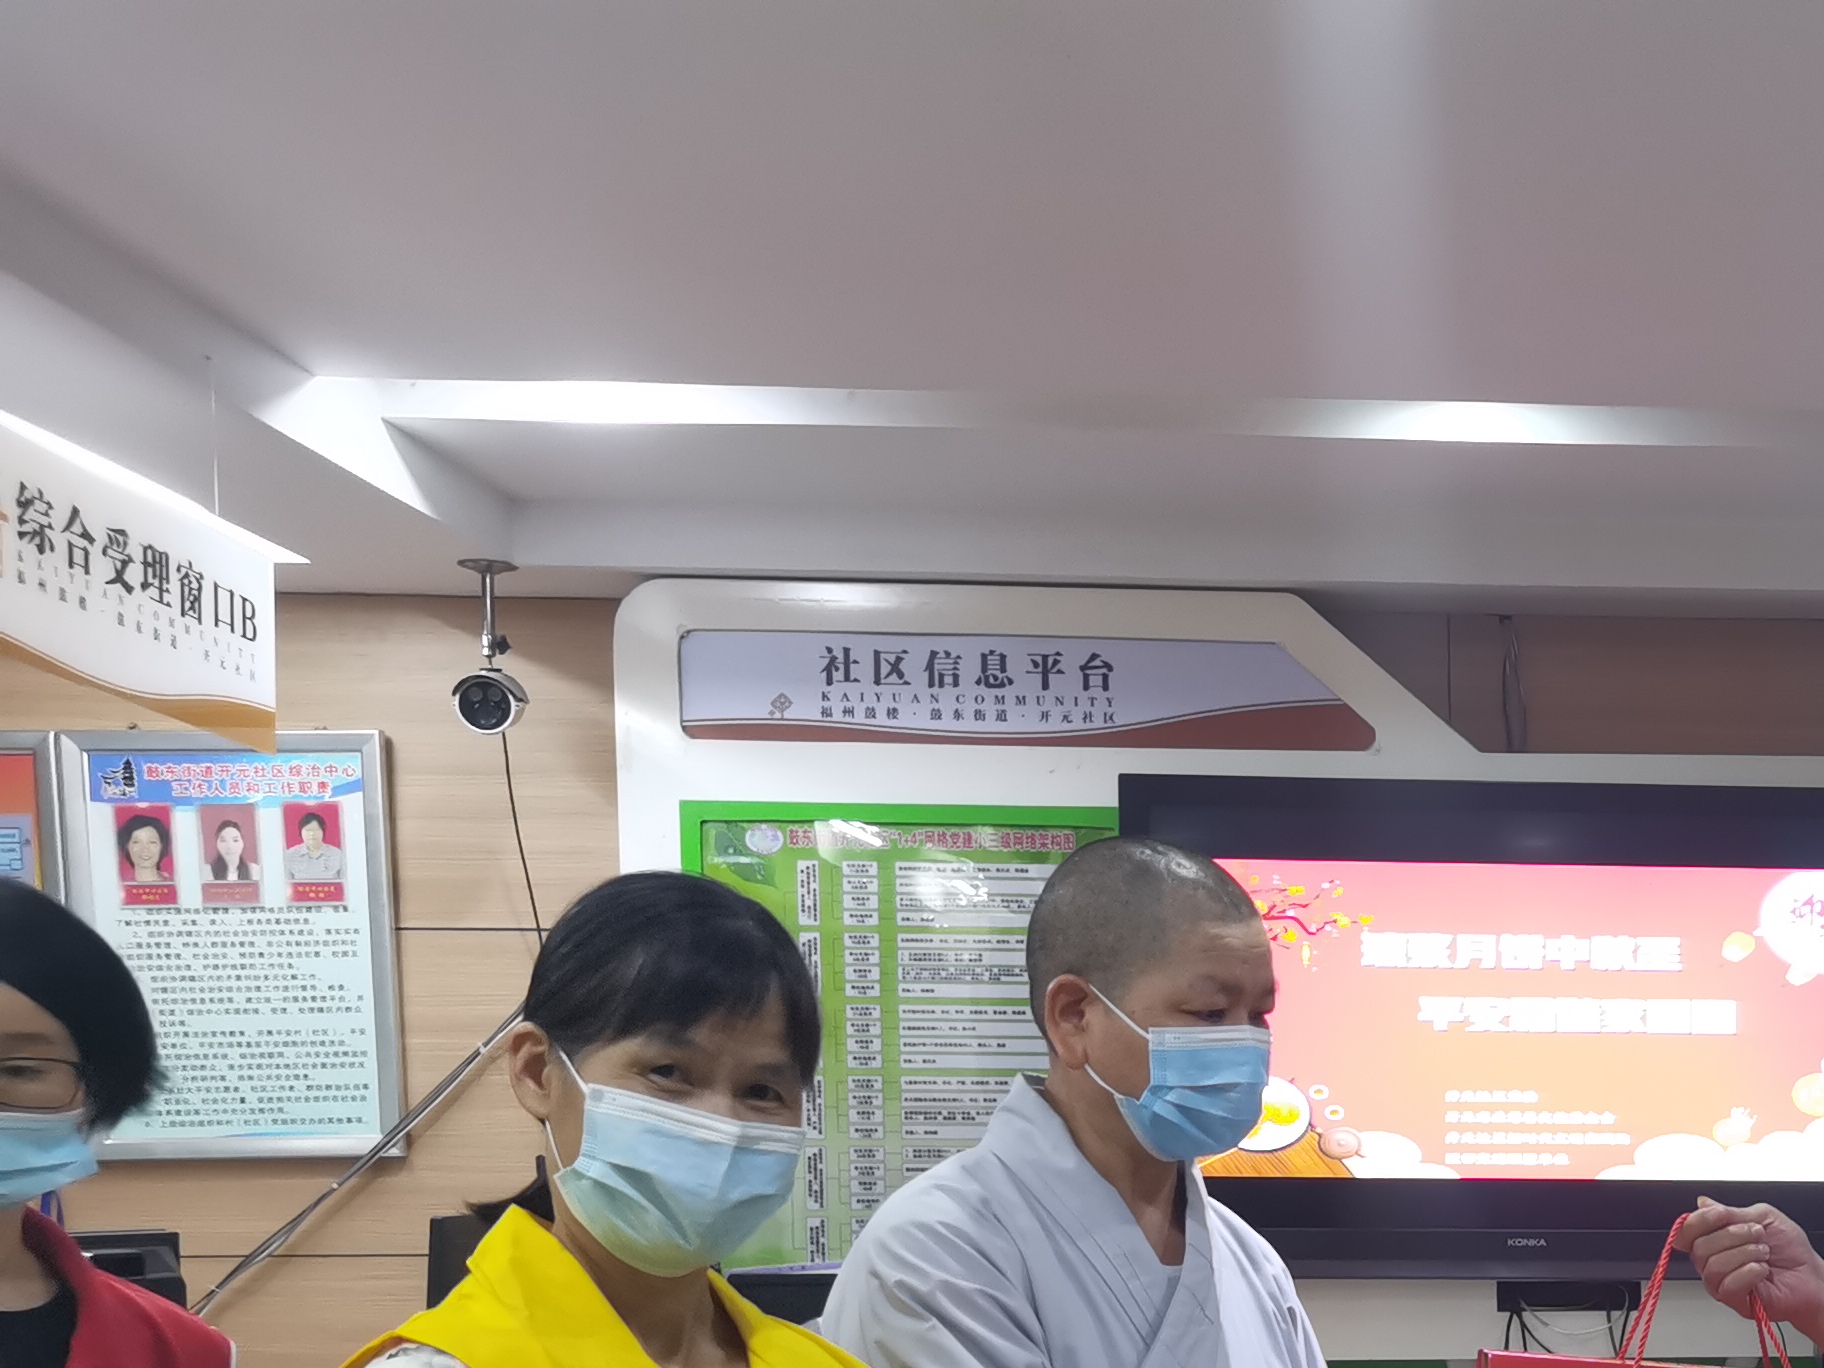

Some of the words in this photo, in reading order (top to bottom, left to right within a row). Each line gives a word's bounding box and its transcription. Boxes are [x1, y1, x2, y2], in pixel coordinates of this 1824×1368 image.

[16, 480, 258, 643] 综合受理窗口B
[818, 645, 1115, 692] 社区信息平台
[821, 691, 941, 705] KAIYUAN
[955, 693, 1115, 708] COMMUNITY
[143, 763, 358, 780] 鼓东街道开元社区综治中心
[173, 780, 332, 797] 工作人员和工作职责
[1507, 1238, 1547, 1247] KONKA
